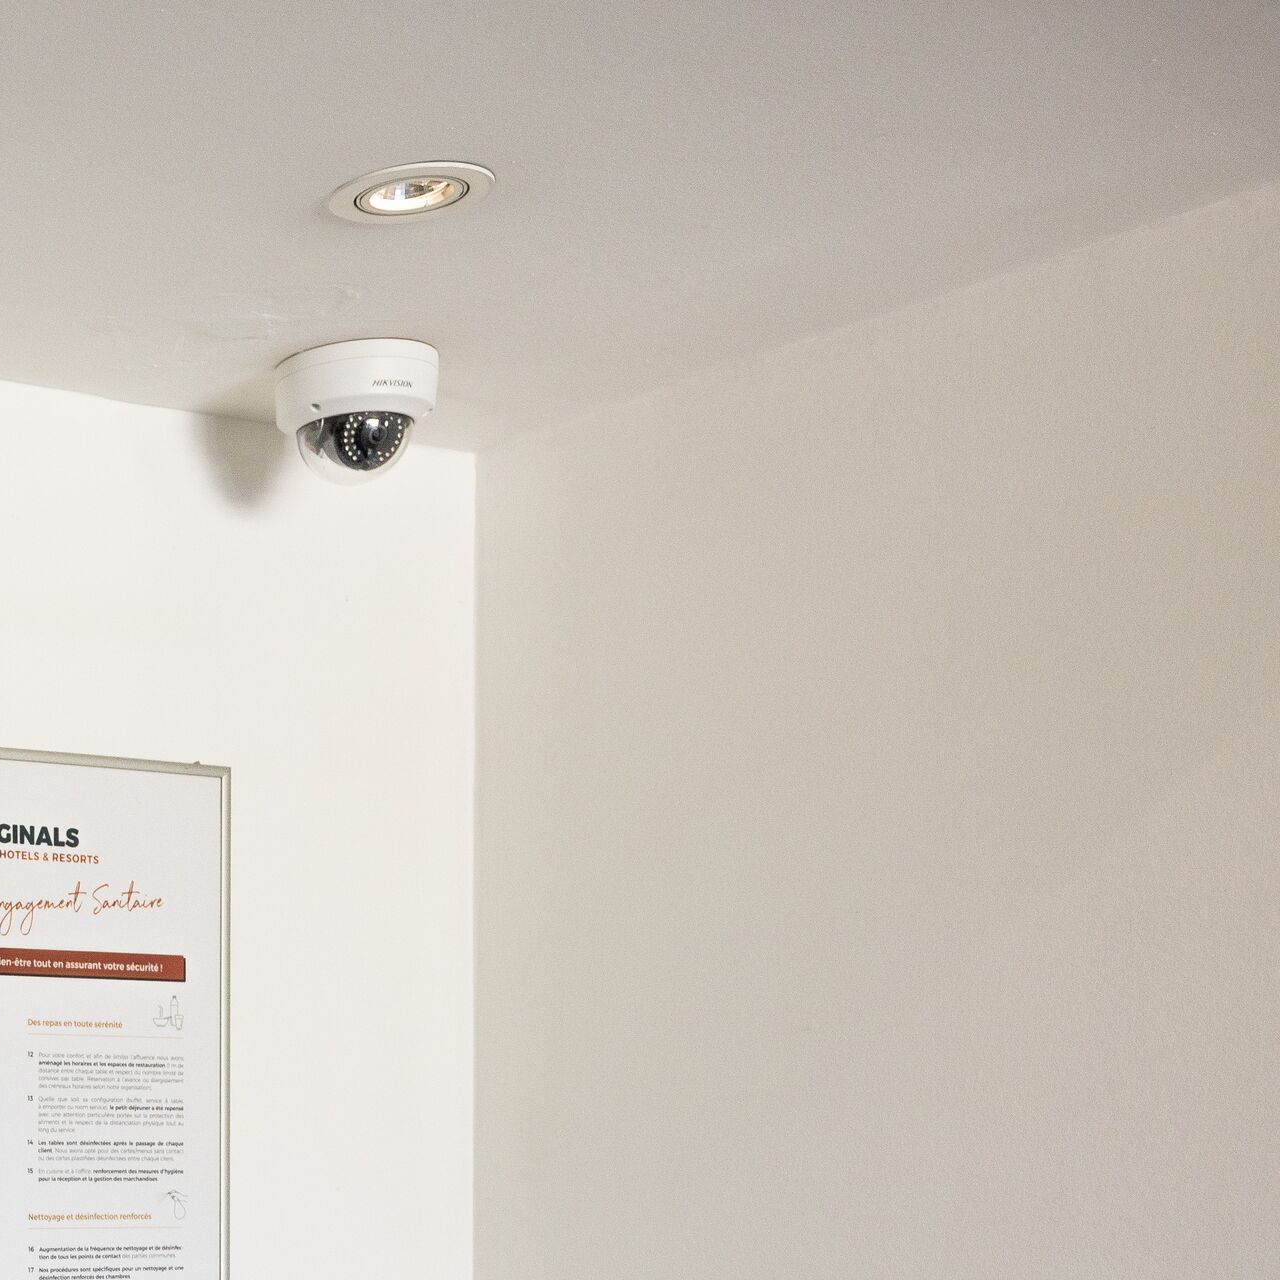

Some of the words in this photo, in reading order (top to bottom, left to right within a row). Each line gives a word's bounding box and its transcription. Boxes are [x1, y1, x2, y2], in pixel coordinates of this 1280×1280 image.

[372, 378, 412, 388] HIKVISION
[42, 852, 48, 861] &
[52, 853, 99, 864] RESORTS
[92, 880, 165, 915] Sanitaire
[33, 959, 50, 968] tout
[65, 960, 101, 969] assurant
[103, 962, 124, 970] votre
[126, 962, 158, 972] sécurité
[42, 1020, 61, 1028] repas
[28, 1213, 65, 1222] Nettoyage
[74, 1212, 118, 1220] désinfection
[119, 1212, 151, 1220] renforcés
